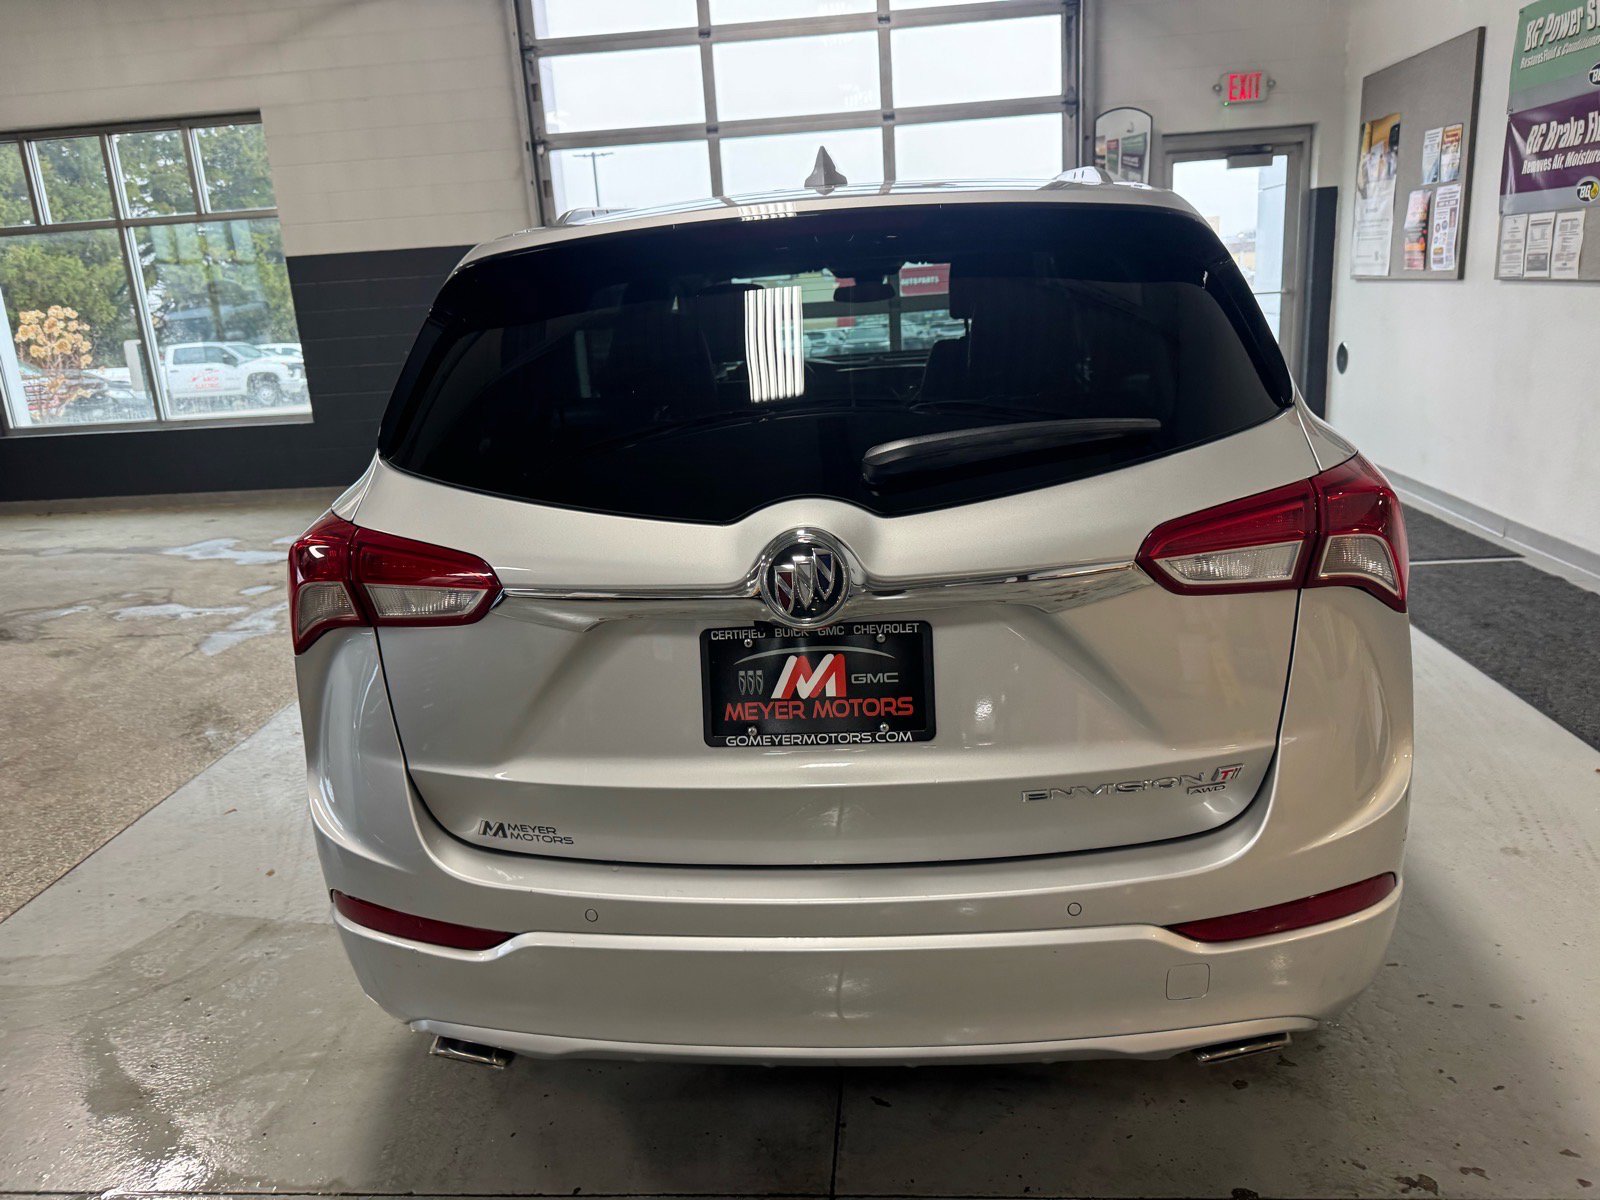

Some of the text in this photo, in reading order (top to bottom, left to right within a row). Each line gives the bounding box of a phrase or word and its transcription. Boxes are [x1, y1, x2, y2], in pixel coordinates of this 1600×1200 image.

[1524, 17, 1544, 51] BG
[1540, 6, 1584, 46] Power
[1229, 73, 1262, 100] EXIT
[1526, 123, 1547, 155] BG
[1542, 116, 1585, 152] Brake
[1521, 157, 1552, 175] Removes
[1579, 184, 1592, 199] BG
[710, 629, 766, 640] CERTIFIED
[818, 625, 845, 636] GMC
[853, 623, 920, 635] CHEVROLET
[851, 672, 899, 684] GMC
[724, 697, 914, 721] MEYER MOTORS
[725, 731, 913, 746] GOMEYERMOTORS.COM
[1021, 772, 1204, 802] ENVISION
[1190, 784, 1226, 795] AWD
[508, 823, 557, 835] MEYER
[510, 833, 575, 845] MOTORS
